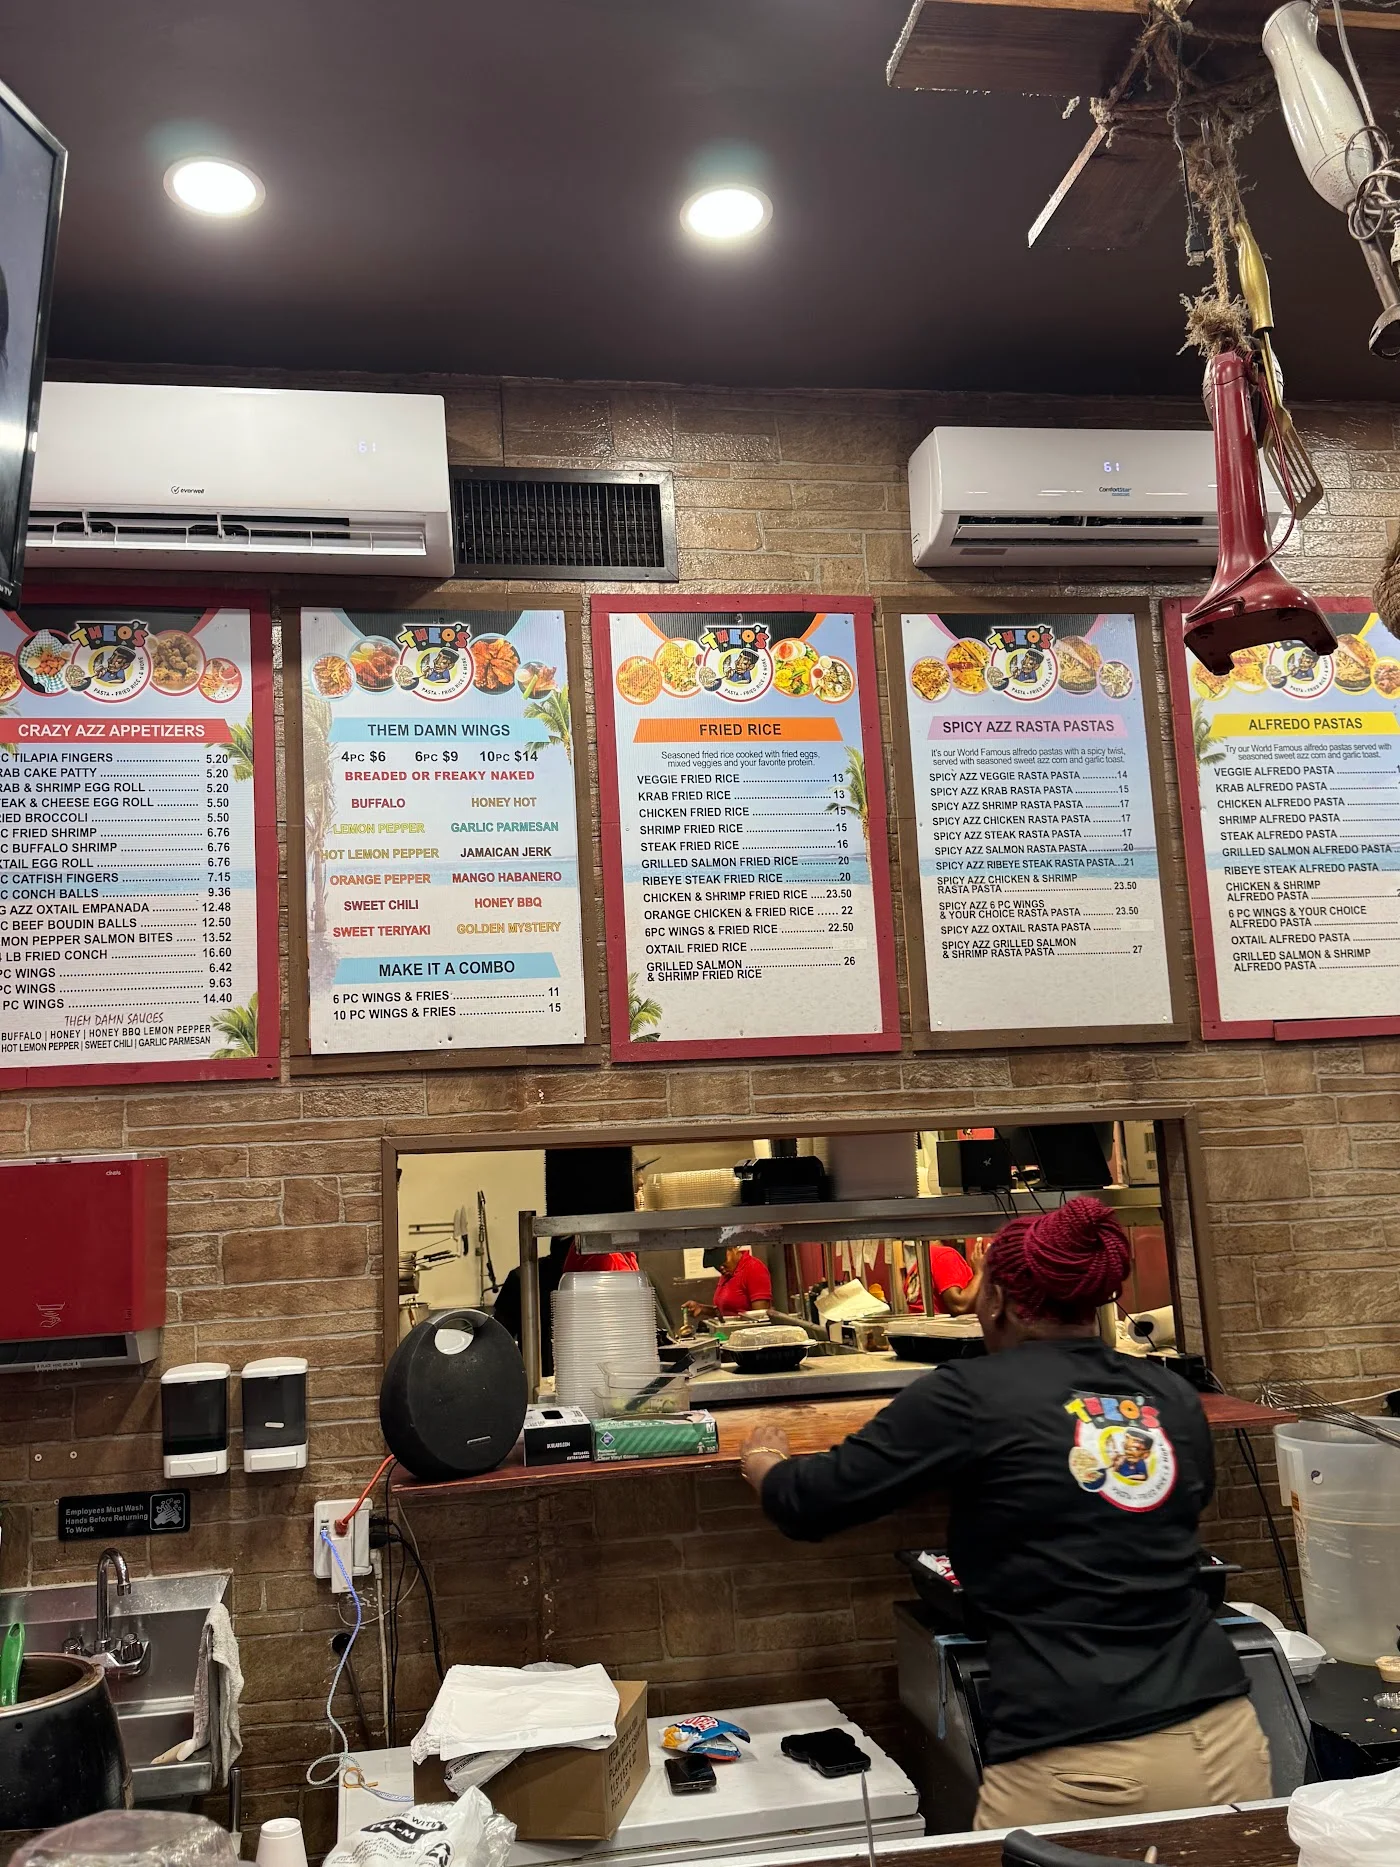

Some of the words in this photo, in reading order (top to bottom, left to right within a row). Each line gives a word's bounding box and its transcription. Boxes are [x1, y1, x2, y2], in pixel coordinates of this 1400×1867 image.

[1103, 462, 1120, 472] 61
[70, 622, 149, 648] THEO'S
[398, 624, 470, 649] THEO'S
[701, 625, 769, 650] THEO'S
[988, 625, 1054, 650] THEO'S
[94, 688, 110, 696] PASTA
[700, 724, 742, 735] FRIED
[748, 723, 781, 735] RICE
[943, 721, 982, 733] SPICY
[986, 721, 1012, 732] AZZ
[1016, 720, 1060, 732] RASTA
[1064, 720, 1114, 731] PASTAS
[1249, 718, 1310, 730] ALFREDO
[1314, 717, 1362, 729] PASTAS
[18, 724, 72, 736] CRAZY
[75, 724, 105, 736] AZZ
[109, 724, 204, 737] APPETIZERS
[368, 724, 408, 736] THEM
[414, 724, 456, 736] DAMN
[461, 724, 510, 736] WINGS
[13, 752, 58, 762] TILAPIA
[62, 753, 112, 762] FINGERS
[206, 753, 228, 763] 5.20
[341, 751, 364, 761] 4PC
[370, 751, 385, 762] $6
[415, 751, 437, 761] 6PC
[442, 750, 458, 762] $9
[480, 751, 509, 761] 10PC
[514, 750, 538, 762] $14
[661, 751, 700, 759] Seasoned
[702, 751, 719, 759] fried
[800, 752, 820, 760] eggs,
[345, 771, 406, 780] BREADED
[412, 771, 430, 780] OR
[434, 771, 485, 780] FREAKY
[491, 771, 534, 780] NAKED
[929, 773, 957, 781] SPICY
[960, 773, 977, 781] AZZ
[979, 772, 1015, 781] VEGGIE
[1018, 771, 1049, 780] RASTA
[1051, 771, 1080, 779] PASTA
[1117, 771, 1127, 779] 14
[1214, 768, 1252, 776] VEGGIE
[1254, 767, 1300, 776] ALFREDO
[1304, 766, 1335, 774] PASTA
[637, 775, 677, 784] VEGGIE
[680, 774, 711, 783] FRIED
[715, 774, 739, 783] RICE
[833, 774, 844, 783] 13
[24, 783, 31, 792] &
[36, 783, 80, 792] SHRIMP
[84, 782, 109, 792] EGG
[114, 782, 145, 791] ROLL
[206, 783, 228, 792] 5.20
[1216, 784, 1243, 792] KRAB
[1247, 783, 1293, 792] ALFREDO
[1296, 782, 1327, 791] PASTA
[638, 791, 668, 801] KRAB
[672, 791, 702, 800] FRIED
[706, 790, 730, 799] RICE
[834, 790, 845, 799] 13
[352, 798, 405, 808] BUFFALO
[472, 797, 510, 807] HONEY
[514, 797, 536, 807] HOT
[25, 813, 87, 822] BROCCOLI
[207, 812, 229, 822] 5.50
[639, 808, 686, 817] CHICKEN
[690, 807, 721, 816] FRIED
[724, 807, 749, 816] RICE
[835, 807, 846, 816] 15
[12, 828, 47, 837] FRIED
[52, 828, 96, 837] SHRIMP
[207, 827, 229, 837] 6.76
[451, 822, 493, 832] GARLIC
[496, 821, 558, 832] PARMESAN
[12, 843, 68, 853] BUFFALO
[72, 842, 117, 852] SHRIMP
[208, 842, 229, 851] 6.76
[460, 847, 518, 857] JAMAICAN
[522, 846, 551, 856] JERK
[12, 873, 62, 883] CATFISH
[66, 873, 118, 883] FINGERS
[208, 872, 230, 881] 7.15
[452, 872, 494, 883] MANGO
[498, 871, 561, 882] HABANERO
[12, 889, 55, 899] CONCH
[60, 888, 98, 898] BALLS
[208, 887, 230, 896] 9.36
[344, 900, 385, 911] SWEET
[388, 899, 418, 910] CHILI
[474, 897, 514, 908] HONEY
[517, 897, 542, 907] BBQ
[10, 905, 32, 915] AZZ
[36, 904, 79, 914] OXTAIL
[82, 903, 150, 913] EMPANADA
[202, 902, 230, 911] 12.48
[333, 926, 375, 937] SWEET
[377, 925, 430, 936] TERIYAKI
[456, 923, 504, 934] GOLDEN
[508, 921, 561, 933] MYSTERY
[379, 963, 422, 976] MAKE
[428, 962, 440, 975] IT
[444, 962, 455, 974] A
[459, 960, 514, 974] COMBO
[333, 994, 339, 1003] 6
[343, 993, 358, 1003] PC
[362, 992, 400, 1002] WINGS
[404, 991, 412, 1001] &
[416, 990, 449, 1001] FRIES
[548, 987, 560, 997] 11
[64, 1015, 90, 1026] THEM
[95, 1014, 123, 1025] DAMN
[127, 1012, 163, 1024] SAUCES
[2, 1031, 41, 1040] BUFFALO
[50, 1029, 81, 1039] HONEY
[89, 1028, 118, 1037] HONEY
[122, 1027, 140, 1036] BBQ
[144, 1026, 173, 1035] LEMON
[177, 1024, 211, 1034] PEPPER
[705, 1423, 716, 1433] M
[65, 1507, 105, 1516] Employees
[106, 1505, 124, 1513] Must
[124, 1504, 144, 1512] Wash
[65, 1517, 88, 1525] Hands
[89, 1516, 112, 1524] Before
[113, 1513, 148, 1521] Returning
